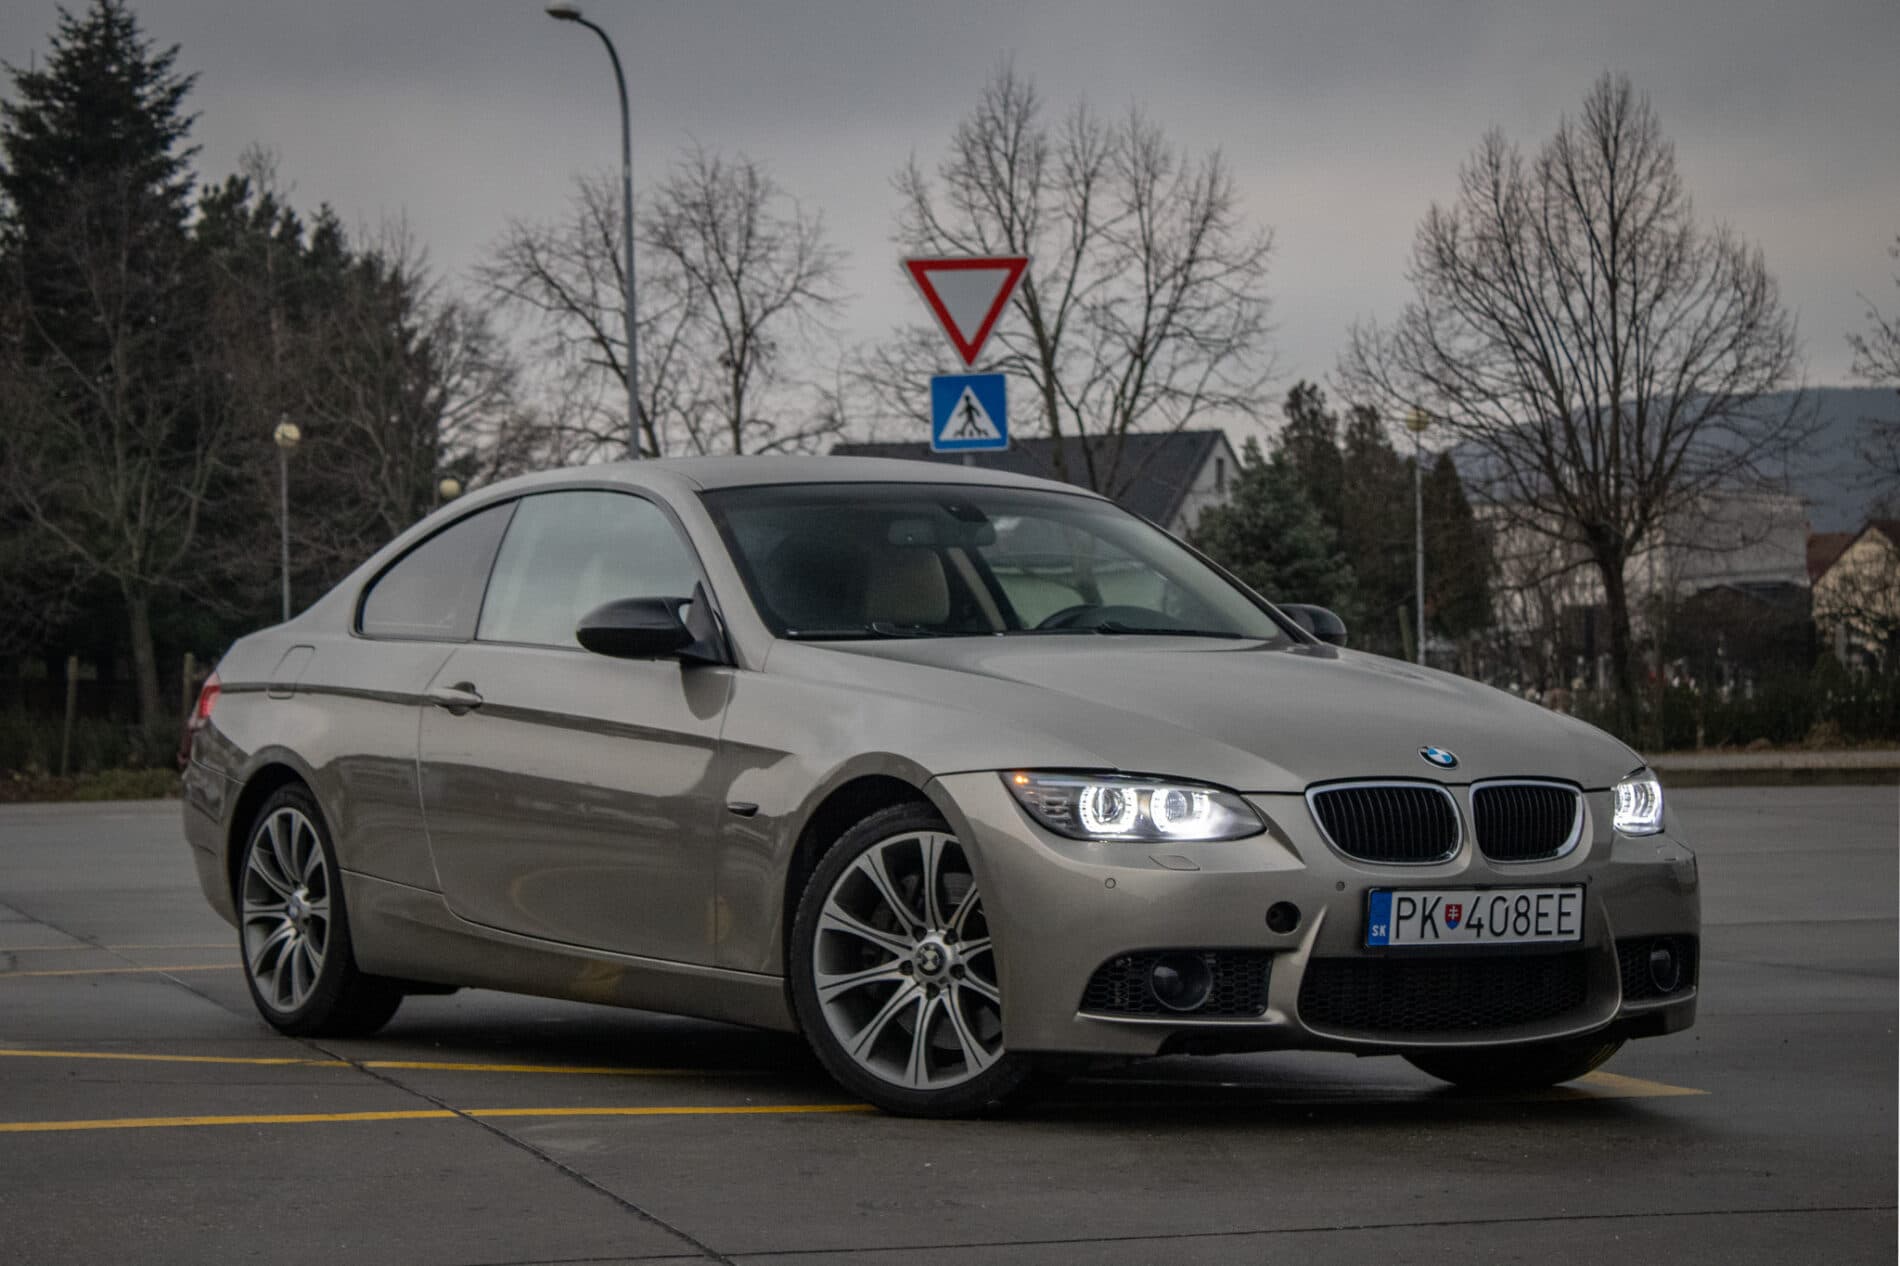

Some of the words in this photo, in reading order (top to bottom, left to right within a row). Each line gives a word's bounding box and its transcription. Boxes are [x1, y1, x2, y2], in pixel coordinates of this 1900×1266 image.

[1371, 924, 1387, 937] SK
[1395, 896, 1443, 939] PK
[1465, 893, 1577, 938] 408EE
